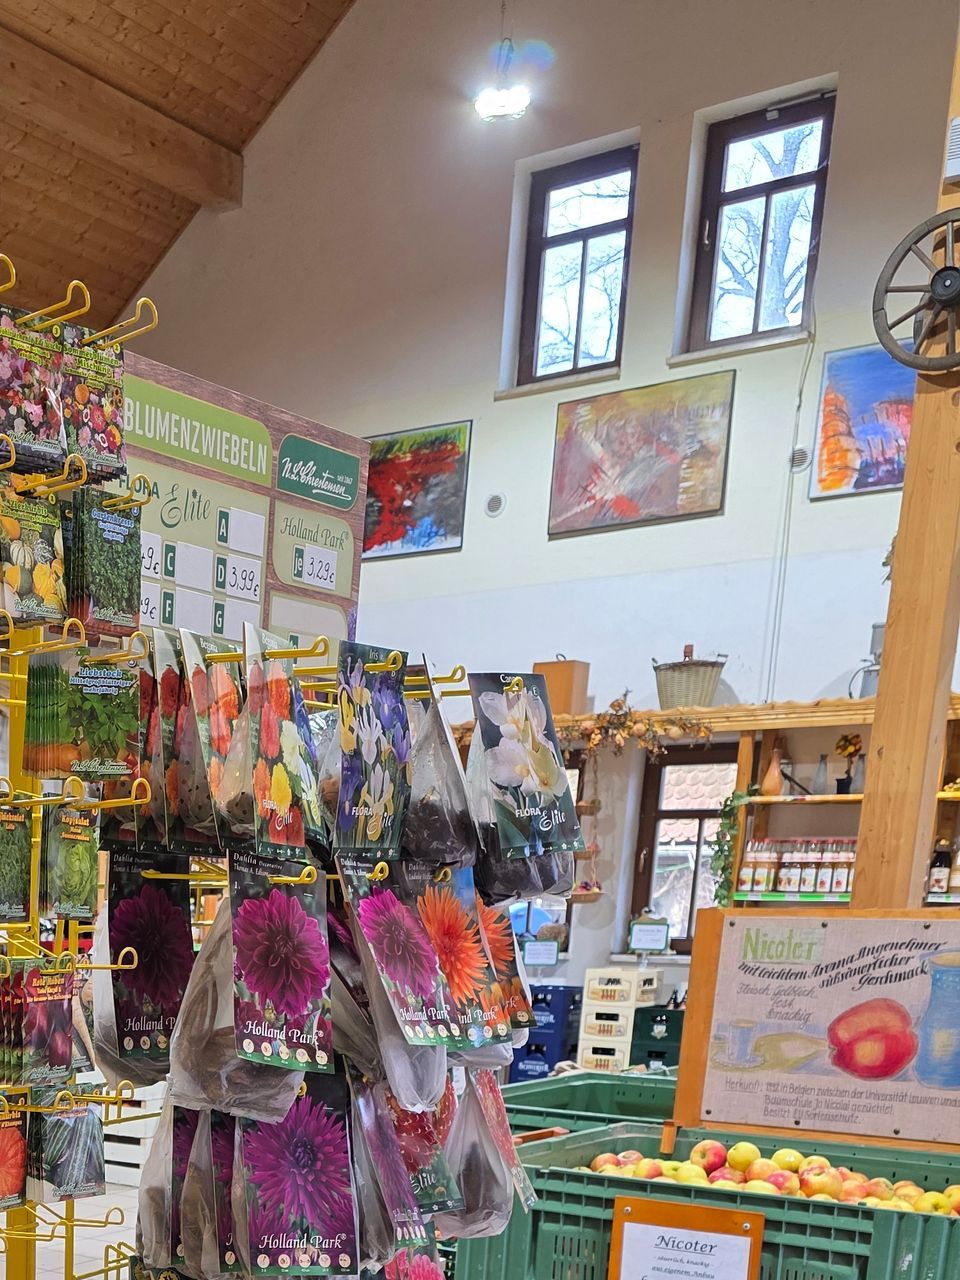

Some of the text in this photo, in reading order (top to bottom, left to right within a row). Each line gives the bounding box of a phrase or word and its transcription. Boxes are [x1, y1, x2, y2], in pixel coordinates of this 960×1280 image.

[124, 397, 268, 475] BLUMENZWIEBELN
[160, 483, 211, 528] Elite
[219, 516, 227, 537] A
[280, 517, 320, 543] Holland
[167, 553, 175, 571] C
[295, 553, 329, 581] je 3,29
[218, 563, 255, 591] D 3,99
[165, 599, 172, 618] F
[216, 609, 223, 628] G
[79, 666, 123, 679] Liebstock
[515, 808, 566, 832] FLORA Elite
[233, 853, 257, 864] Dahlia
[743, 927, 818, 961] Nicoter
[123, 1016, 163, 1032] Holland
[244, 1021, 286, 1041] Holland
[258, 1234, 308, 1250] Holland
[655, 1235, 717, 1253] Nicoter
